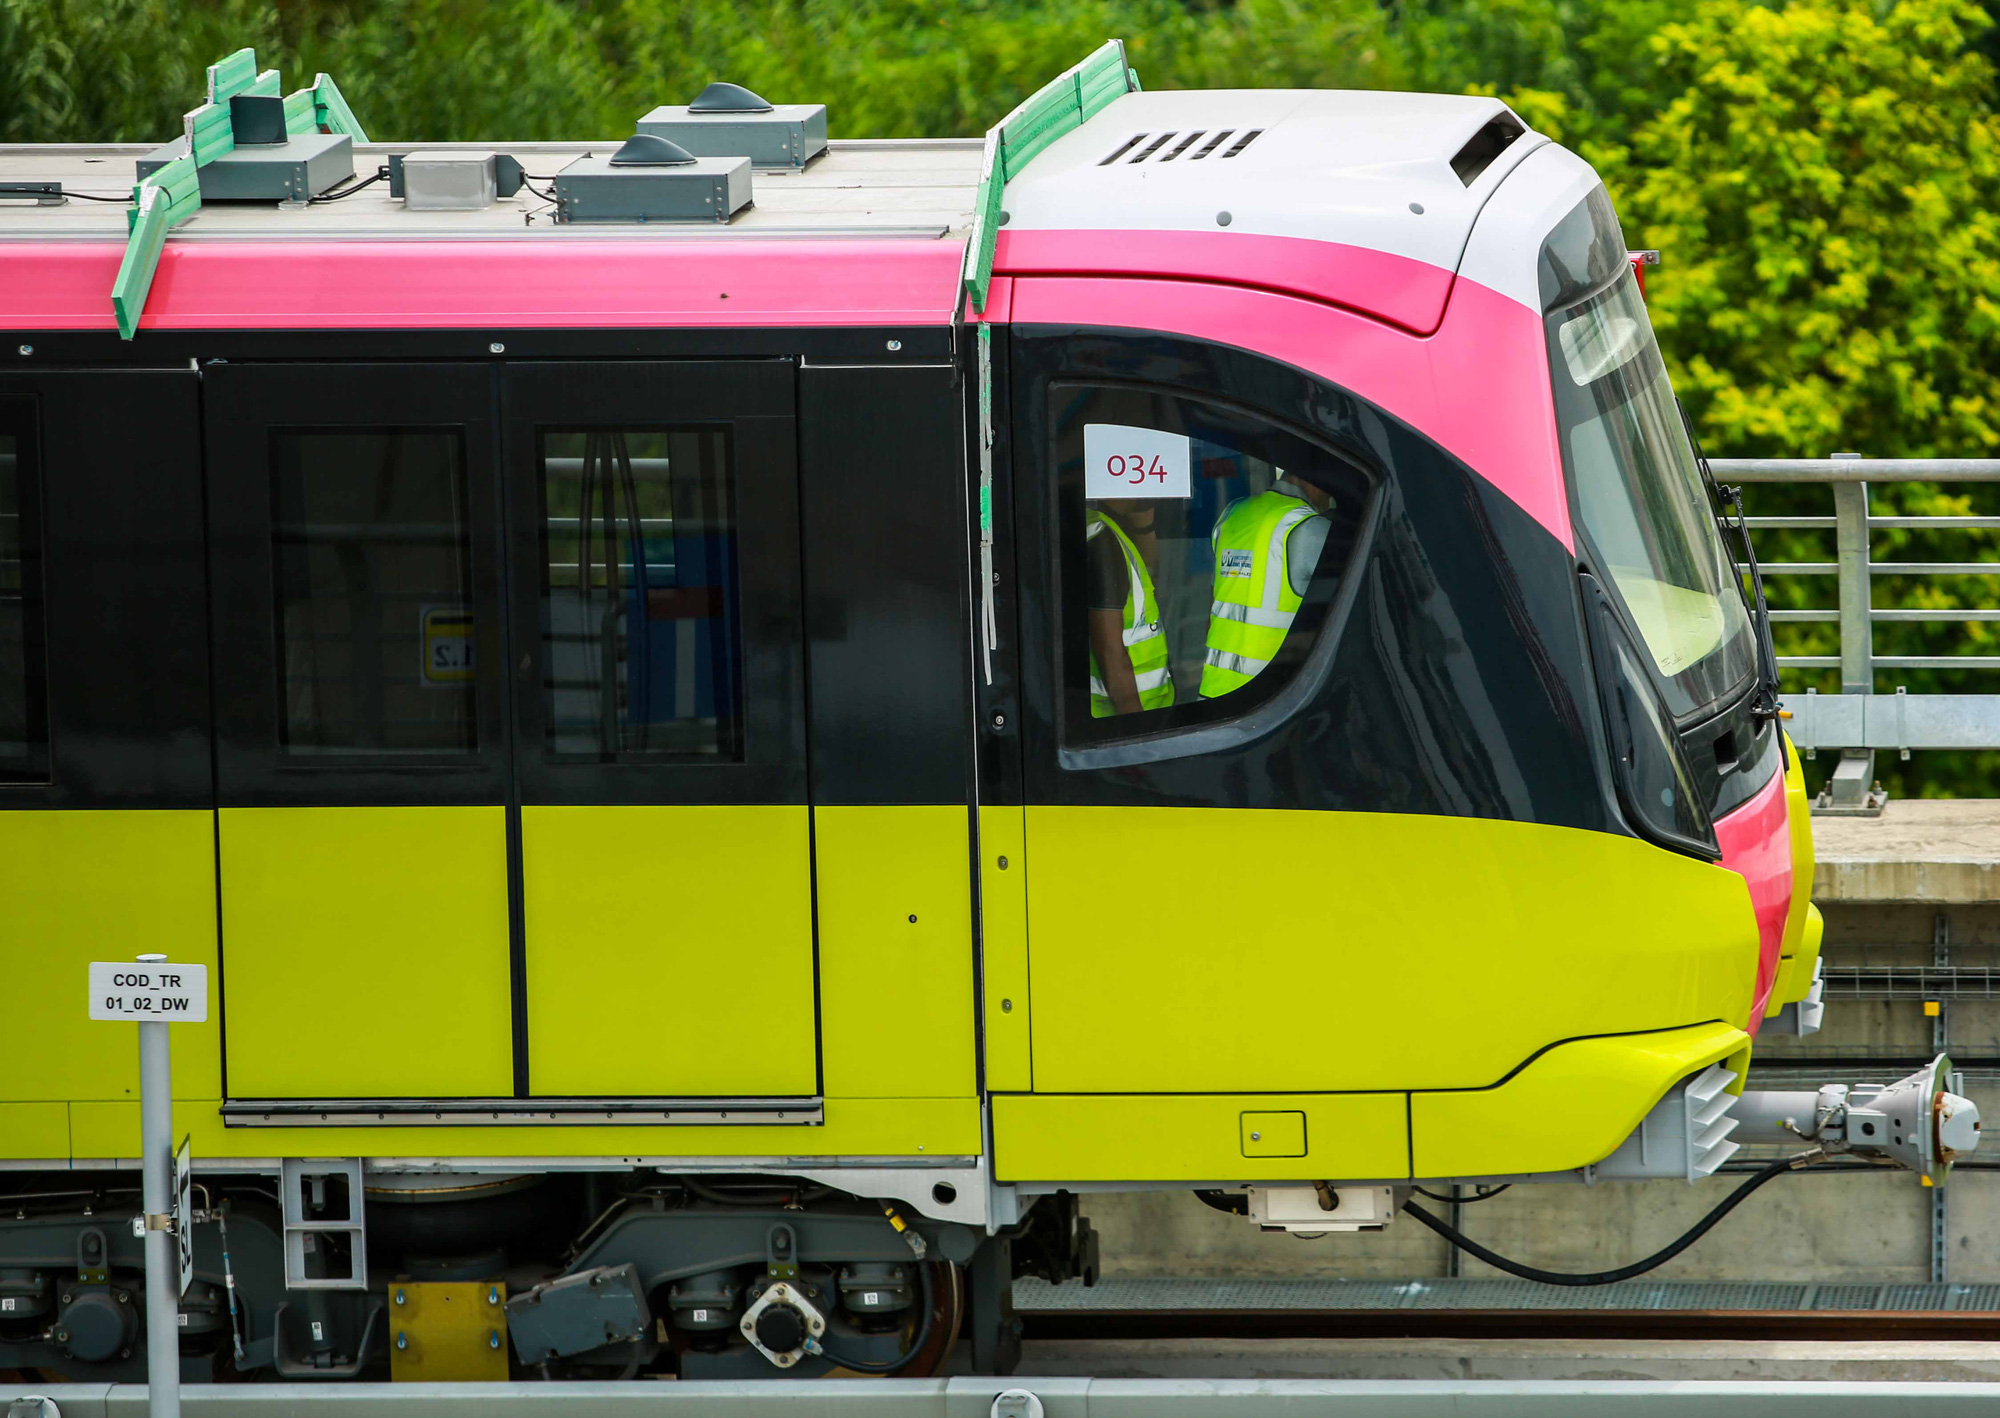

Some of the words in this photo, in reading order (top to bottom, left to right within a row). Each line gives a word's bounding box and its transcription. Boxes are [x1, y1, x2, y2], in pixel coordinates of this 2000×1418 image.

[1107, 455, 1168, 484] 034
[113, 974, 181, 990] COD_TR
[106, 997, 189, 1013] 01_02_DW
